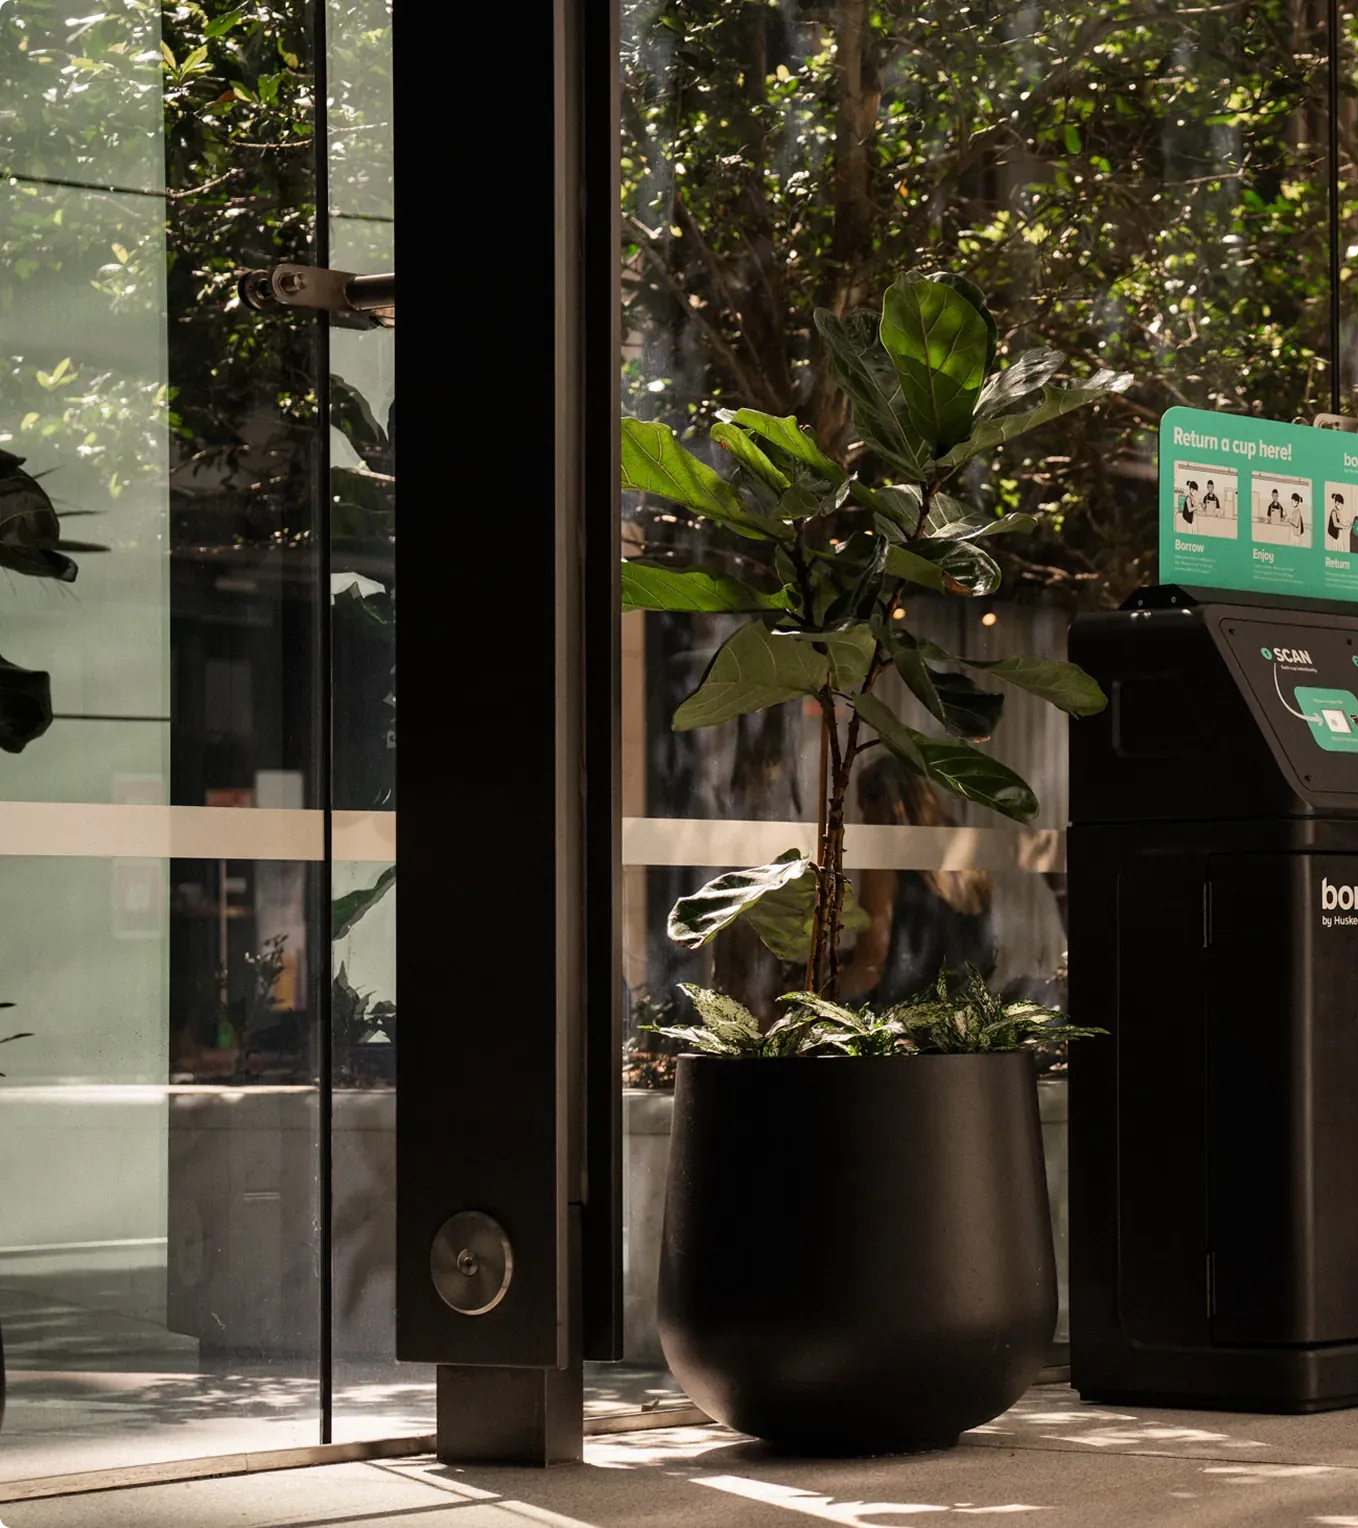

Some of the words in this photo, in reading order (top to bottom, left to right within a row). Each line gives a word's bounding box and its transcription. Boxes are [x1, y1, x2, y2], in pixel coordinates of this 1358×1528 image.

[1173, 426, 1218, 450] Return
[1221, 438, 1230, 452] a
[1232, 440, 1256, 460] cup
[1259, 439, 1292, 461] here!
[1175, 539, 1204, 553] Borrow
[1252, 548, 1274, 564] Enjoy
[1325, 556, 1350, 570] Return
[1273, 648, 1313, 664] SCAN
[1322, 915, 1332, 928] by
